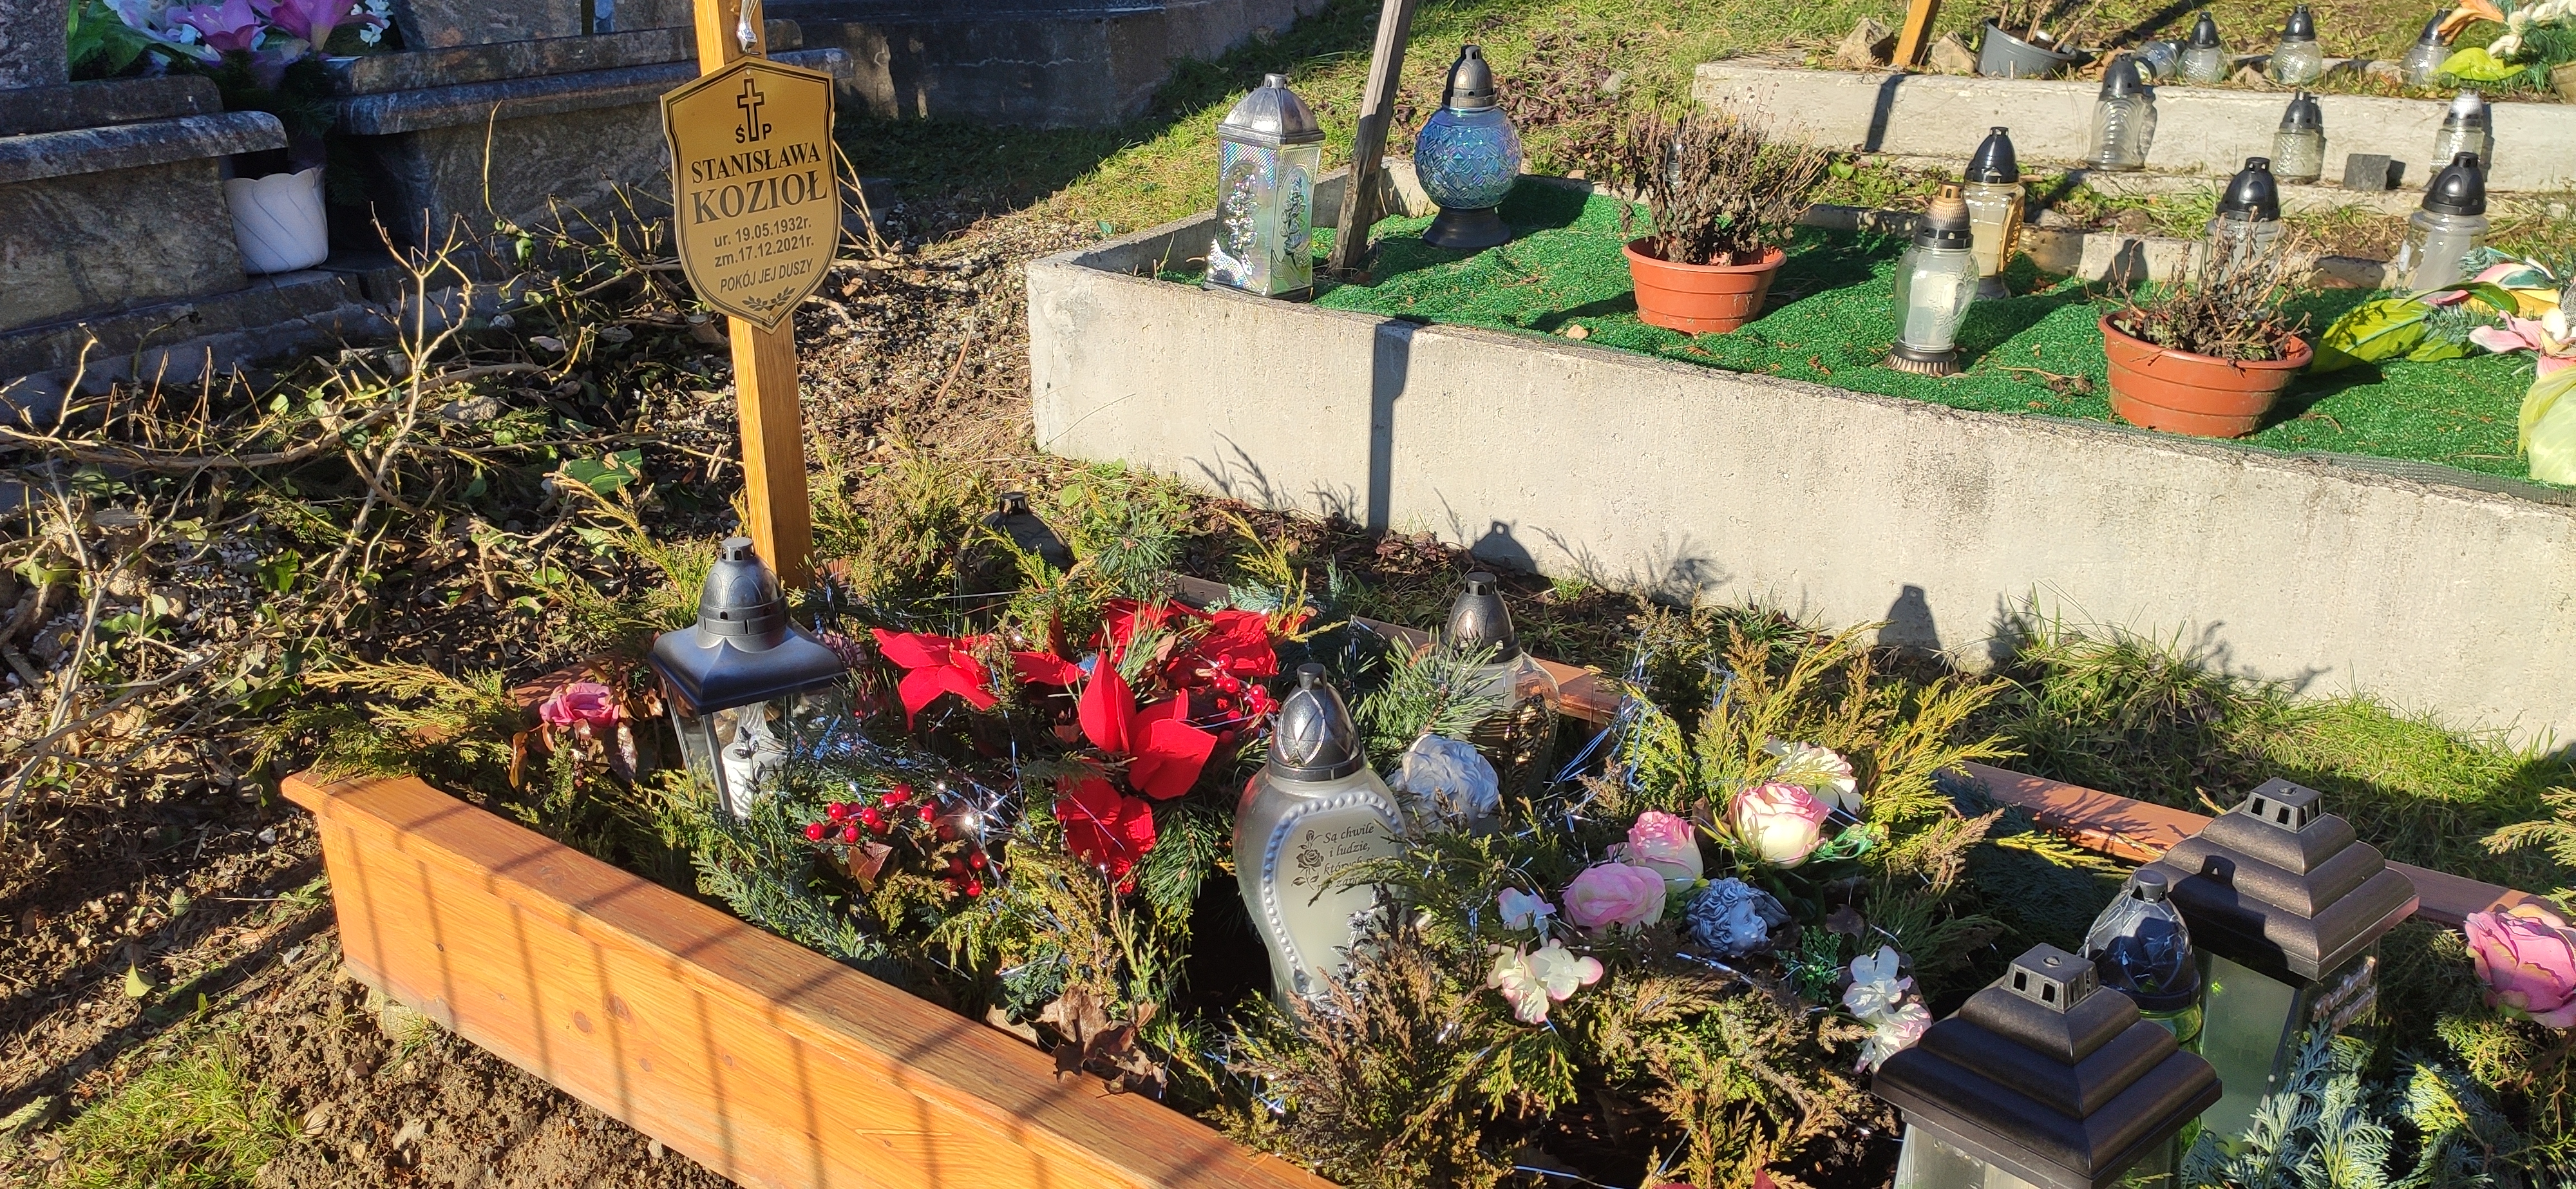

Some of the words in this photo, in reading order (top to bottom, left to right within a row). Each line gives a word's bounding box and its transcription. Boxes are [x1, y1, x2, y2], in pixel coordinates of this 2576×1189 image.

[735, 124, 745, 144] Ś
[762, 124, 772, 140] P
[691, 141, 821, 184] STANISŁAWA
[690, 170, 828, 225] KOZIOŁ
[714, 234, 731, 247] ur.
[735, 216, 811, 243] 19.05.1932r.
[721, 269, 756, 294] POKÓJ
[759, 266, 776, 284] JEJ
[779, 258, 813, 279] DUSZY
[1323, 832, 1338, 843] Są
[1341, 823, 1374, 839] chwile
[1330, 847, 1334, 857] i
[1336, 841, 1370, 856] ludzie,
